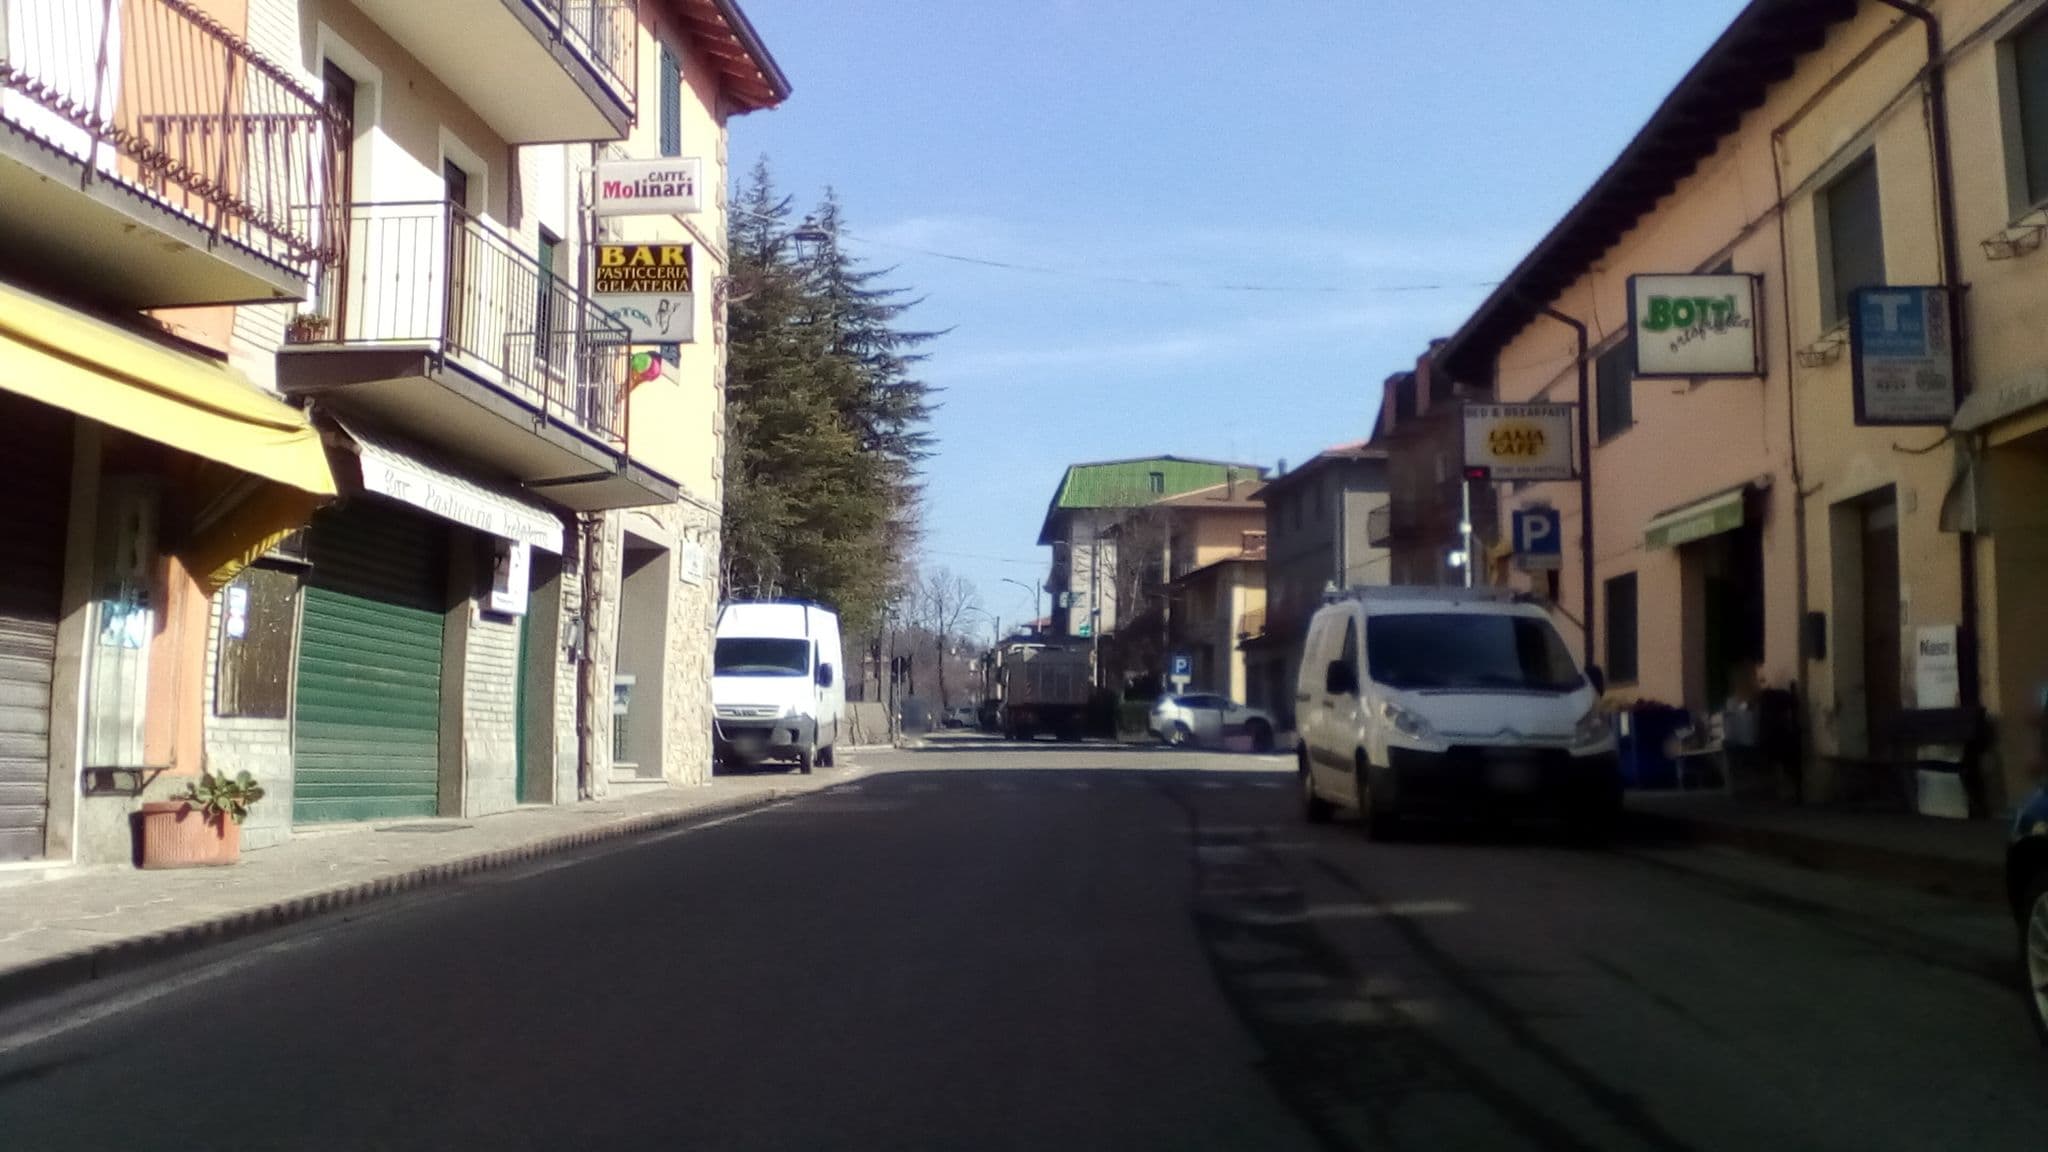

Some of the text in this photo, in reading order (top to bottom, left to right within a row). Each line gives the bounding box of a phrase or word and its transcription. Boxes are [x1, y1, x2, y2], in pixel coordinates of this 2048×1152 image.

[603, 177, 693, 199] Molinari
[601, 245, 687, 266] BAR
[596, 266, 689, 280] PASTICCERIA
[596, 280, 689, 292] GELATERIA
[1522, 515, 1551, 551] P
[1176, 659, 1187, 673] P
